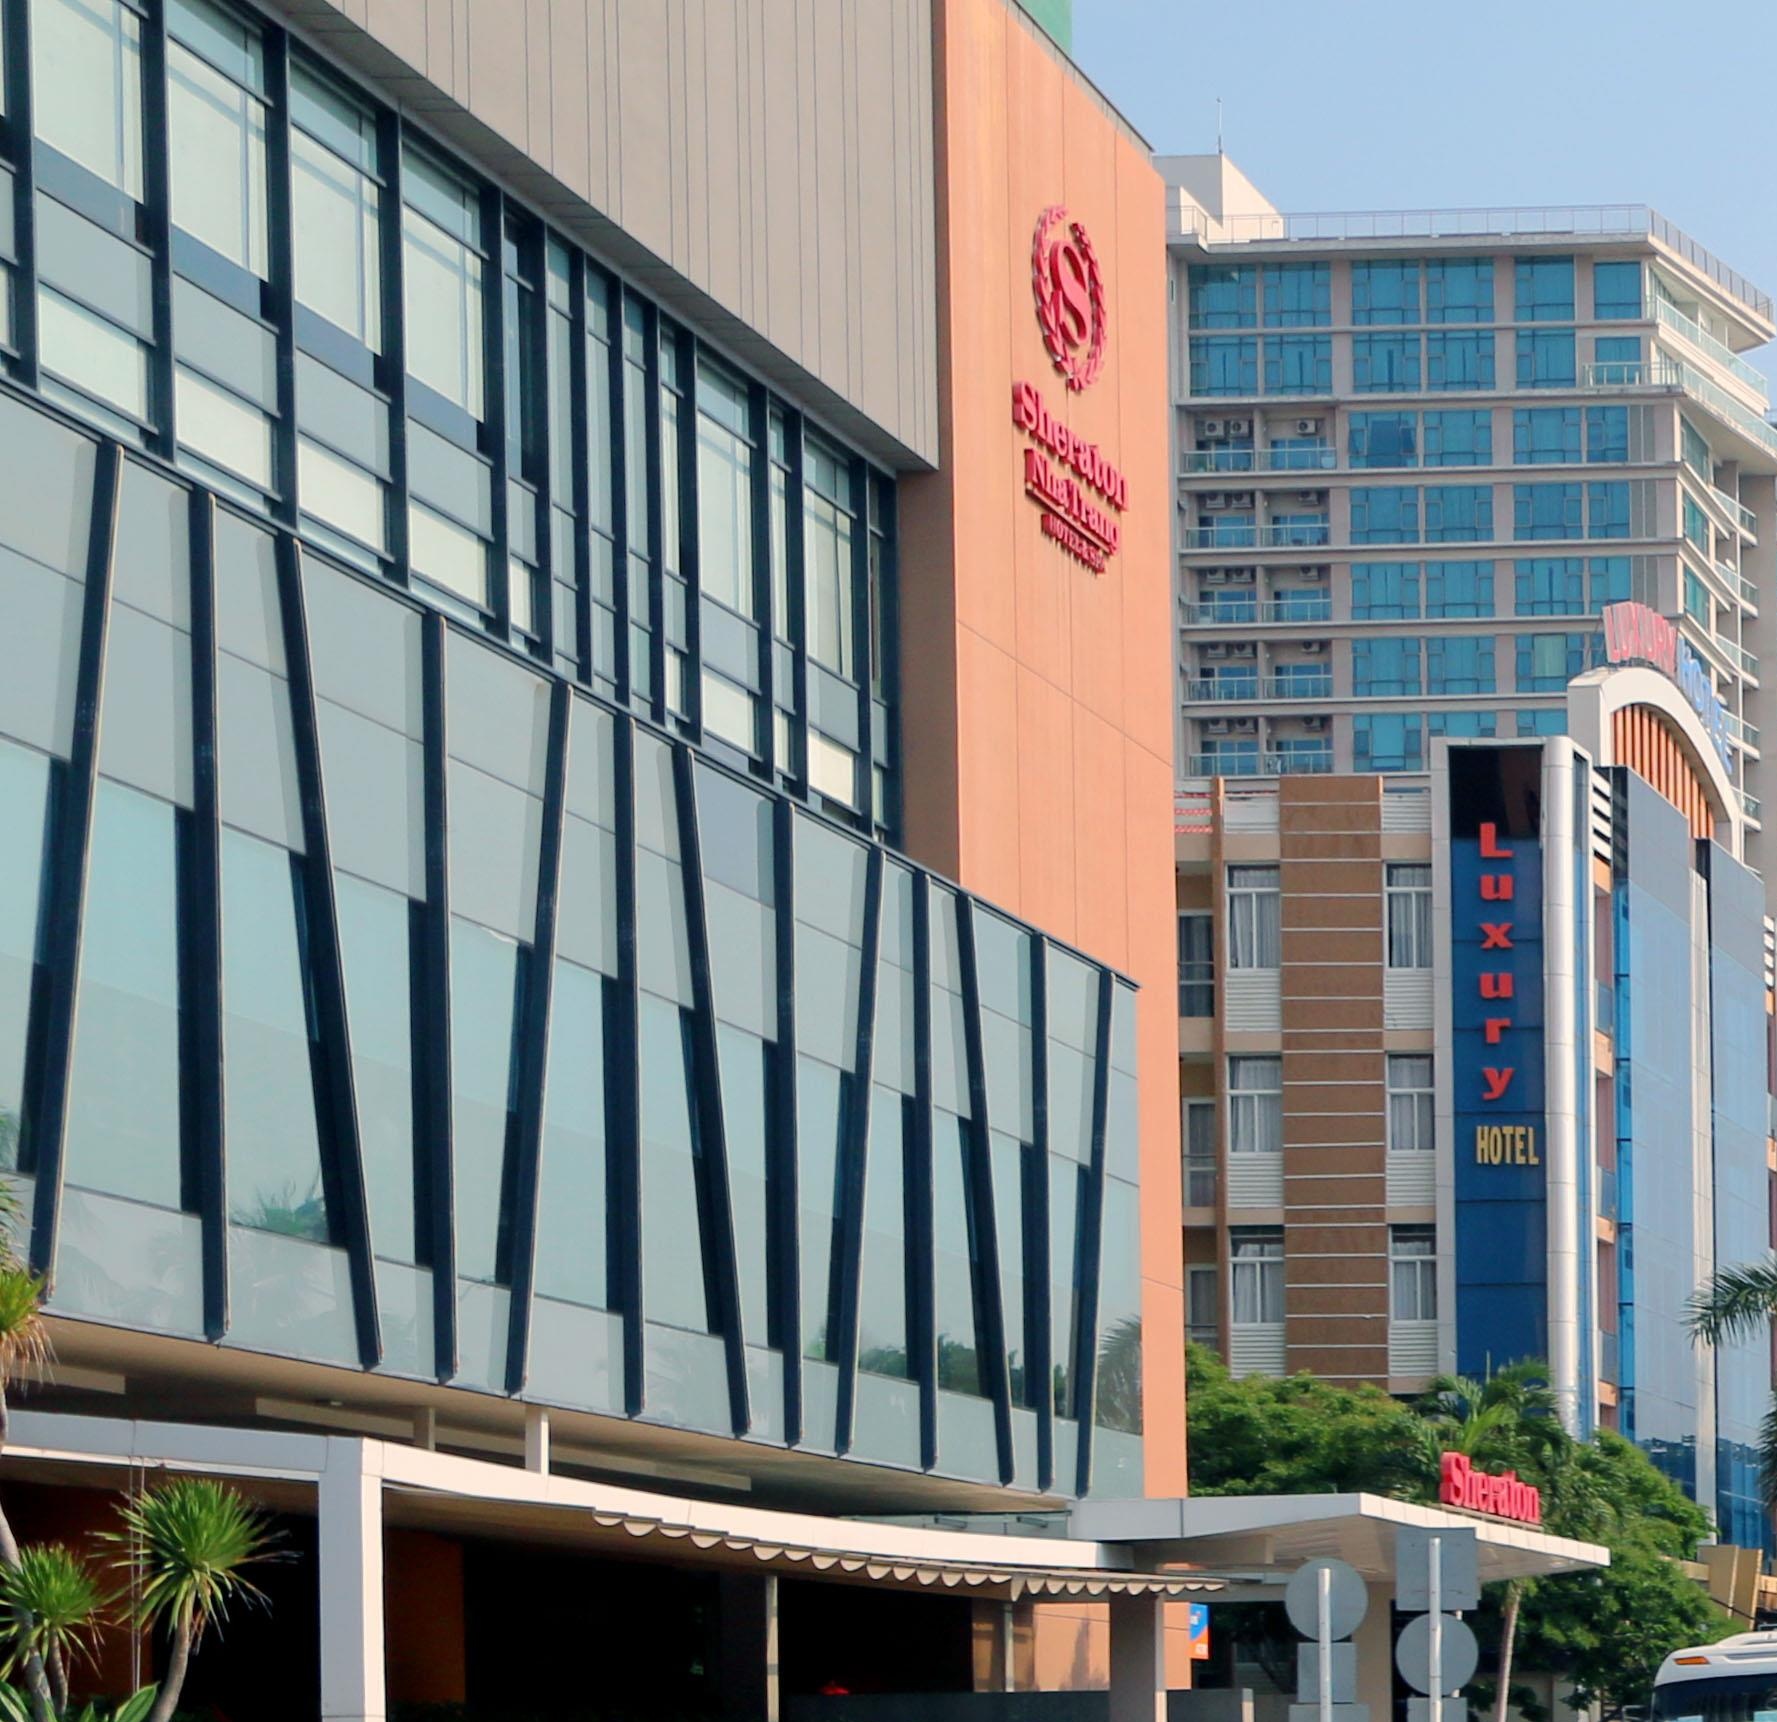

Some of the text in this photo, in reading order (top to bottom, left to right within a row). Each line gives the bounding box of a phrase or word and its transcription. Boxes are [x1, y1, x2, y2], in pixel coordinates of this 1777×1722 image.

[1012, 382, 1130, 512] Sheraton
[1024, 448, 1120, 556] Nha Trang
[1479, 822, 1515, 1100] Luxury
[1476, 1126, 1540, 1165] HOTEL
[1440, 1451, 1542, 1525] Sheraton
